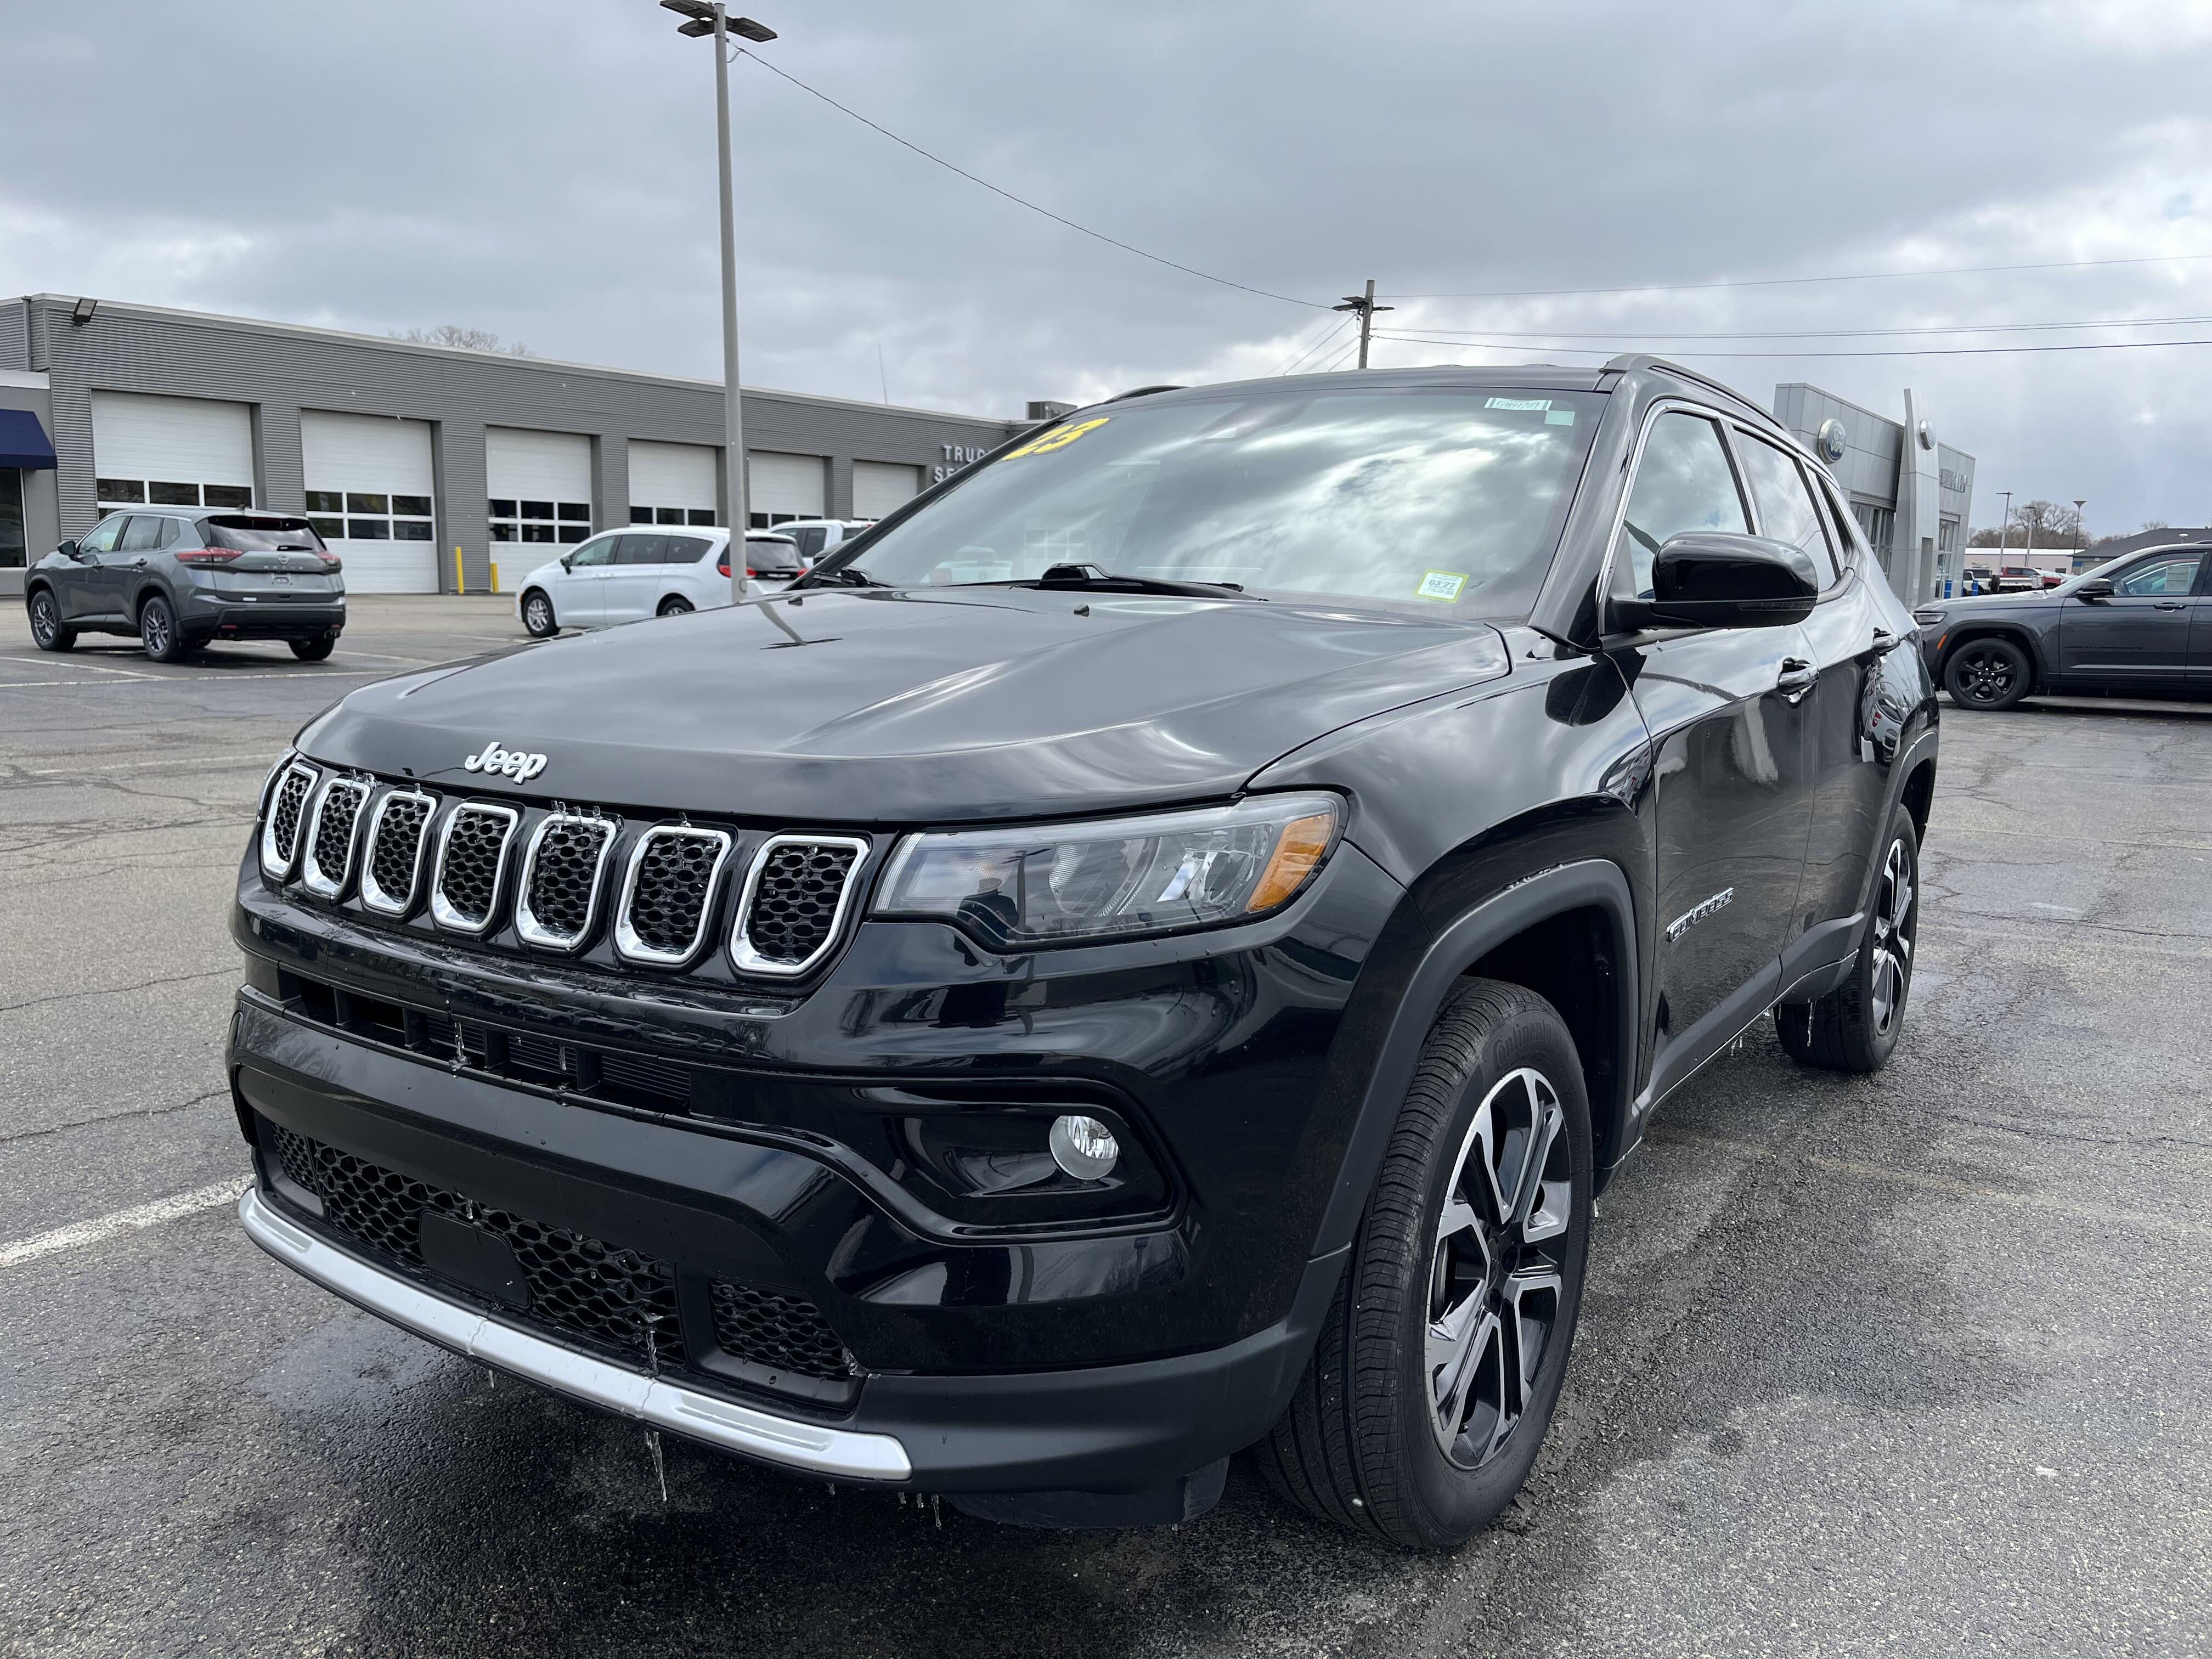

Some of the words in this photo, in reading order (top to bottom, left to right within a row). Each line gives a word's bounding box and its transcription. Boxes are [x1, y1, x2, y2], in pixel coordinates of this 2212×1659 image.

[943, 445, 988, 462] TRUC
[465, 741, 548, 785] Jeep
[1666, 887, 1734, 943] COMPASS
